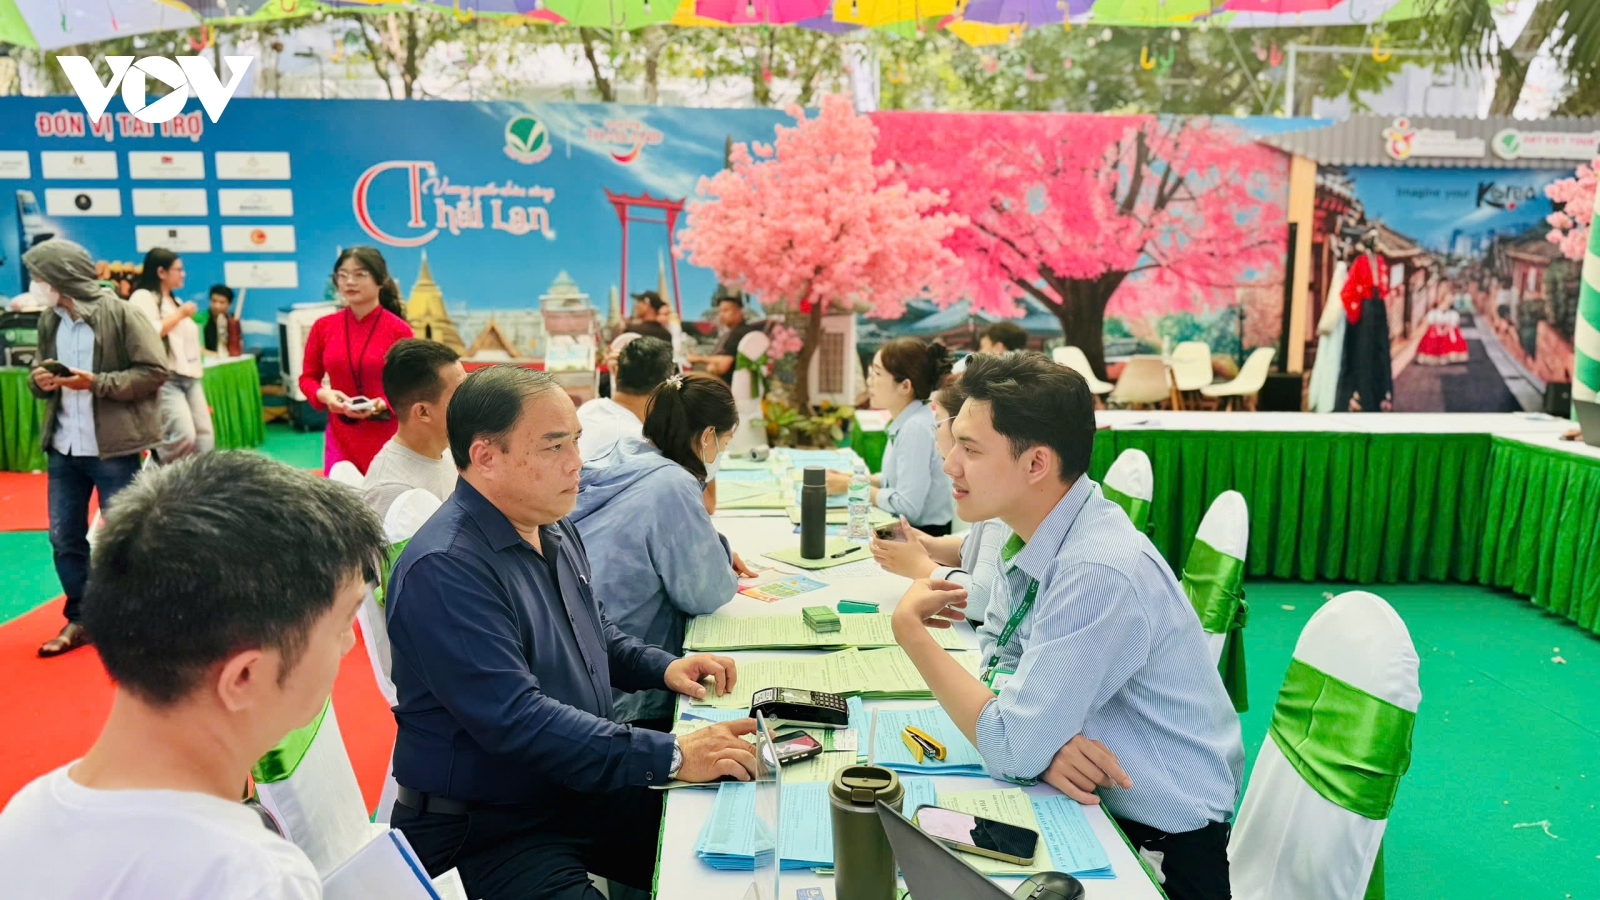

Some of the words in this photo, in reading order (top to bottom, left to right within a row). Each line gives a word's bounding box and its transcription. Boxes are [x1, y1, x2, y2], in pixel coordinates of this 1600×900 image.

[36, 109, 85, 137] ĐƠN
[1476, 181, 1537, 208] Korea
[490, 199, 556, 240] Lan
